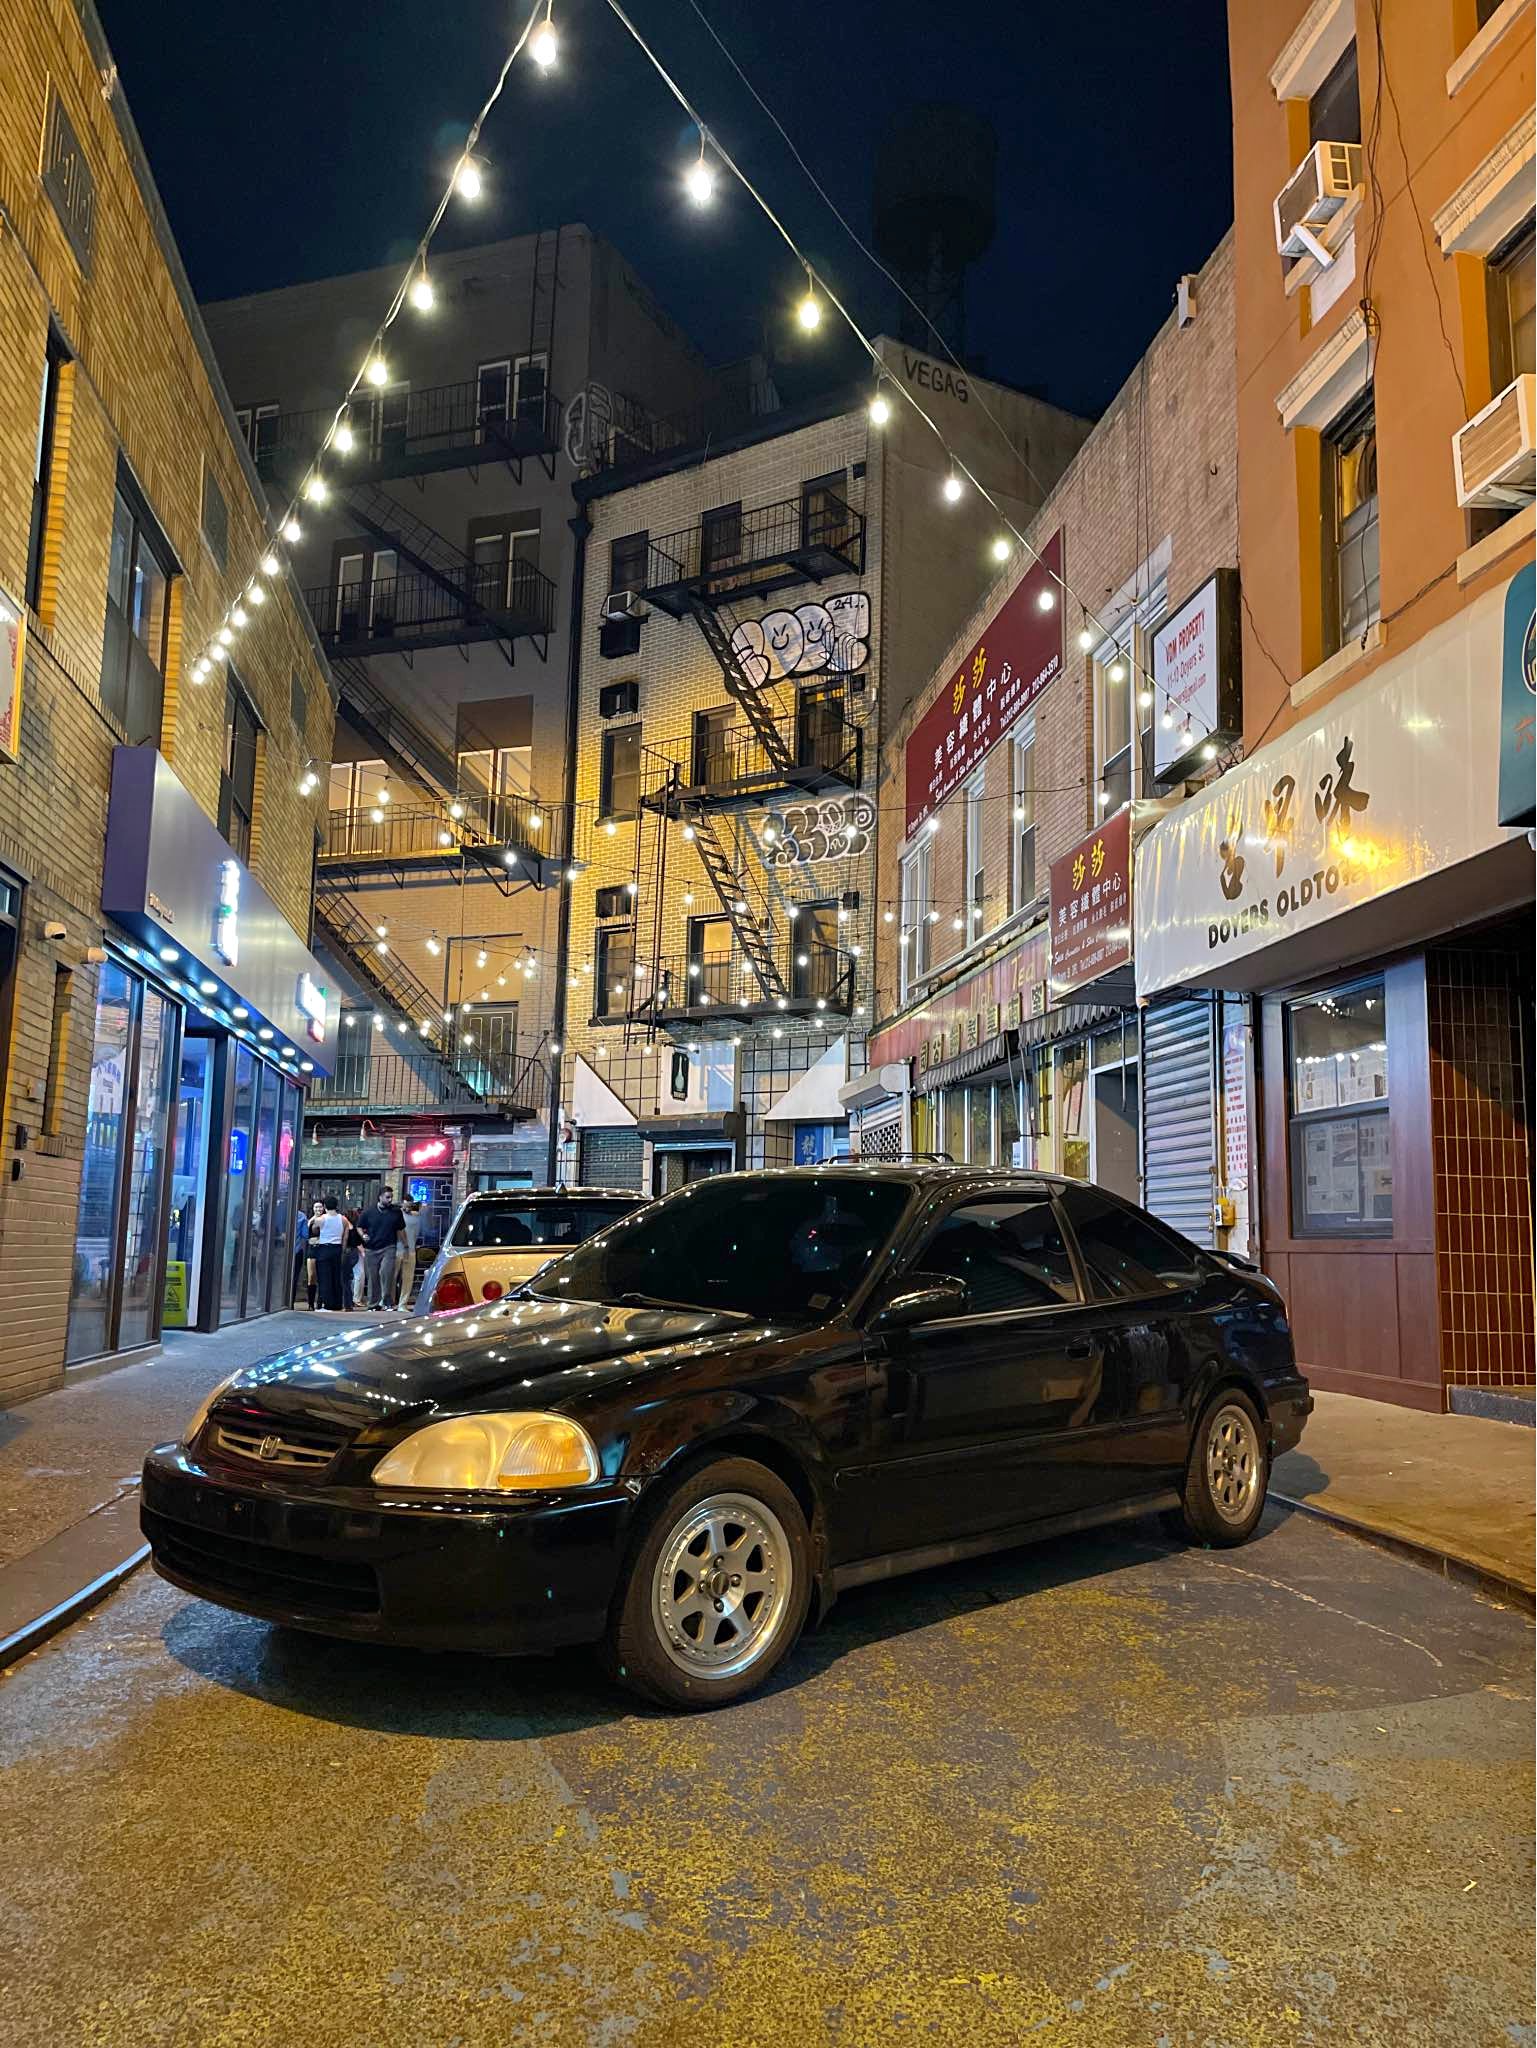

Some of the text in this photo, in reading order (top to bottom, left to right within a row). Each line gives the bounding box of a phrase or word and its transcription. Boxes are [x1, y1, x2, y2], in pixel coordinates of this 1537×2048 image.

[904, 355, 969, 404] VEGAS
[1179, 609, 1205, 653] PROPERTY
[1208, 856, 1361, 949] DOYERS OLDTO
